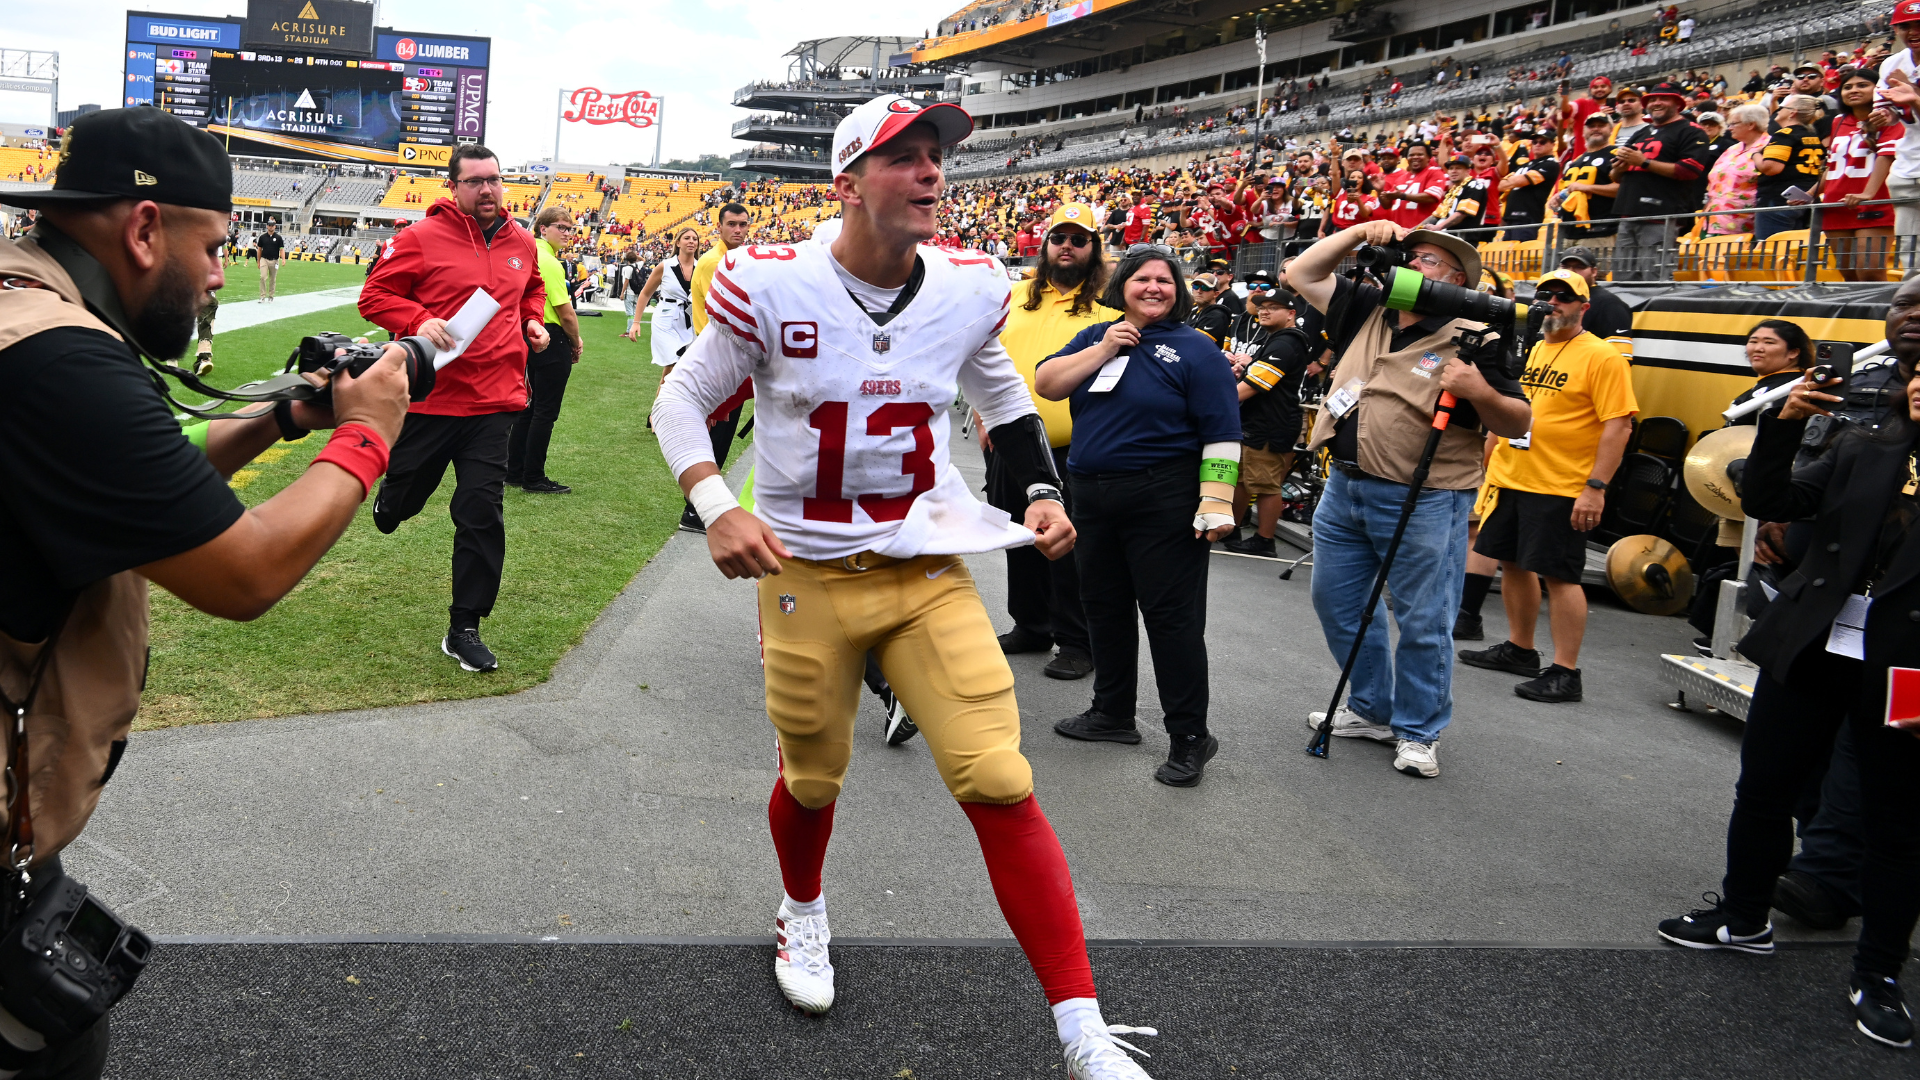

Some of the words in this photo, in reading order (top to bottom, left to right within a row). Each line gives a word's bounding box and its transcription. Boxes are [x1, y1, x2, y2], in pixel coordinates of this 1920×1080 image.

[150, 25, 178, 37] BUD
[179, 27, 218, 40] LIGHT
[271, 22, 346, 36] ACRISURE
[284, 34, 329, 44] STADIUM
[138, 52, 154, 60] PNC
[398, 42, 414, 56] 84
[418, 44, 469, 60] LUMBER
[22, 84, 50, 93] Company
[135, 98, 152, 106] PNC
[464, 74, 482, 132] UPMC
[266, 110, 343, 124] ACRISURE
[281, 123, 326, 134] STADIUM
[419, 149, 447, 161] PNC
[839, 136, 863, 165] 49ERS
[784, 324, 815, 348] C
[875, 342, 888, 350] NFL
[1420, 357, 1434, 368] NFL
[1411, 366, 1432, 379] MEDIA
[860, 380, 901, 395] 49ERS
[803, 401, 935, 523] 13
[782, 602, 792, 611] NFL
